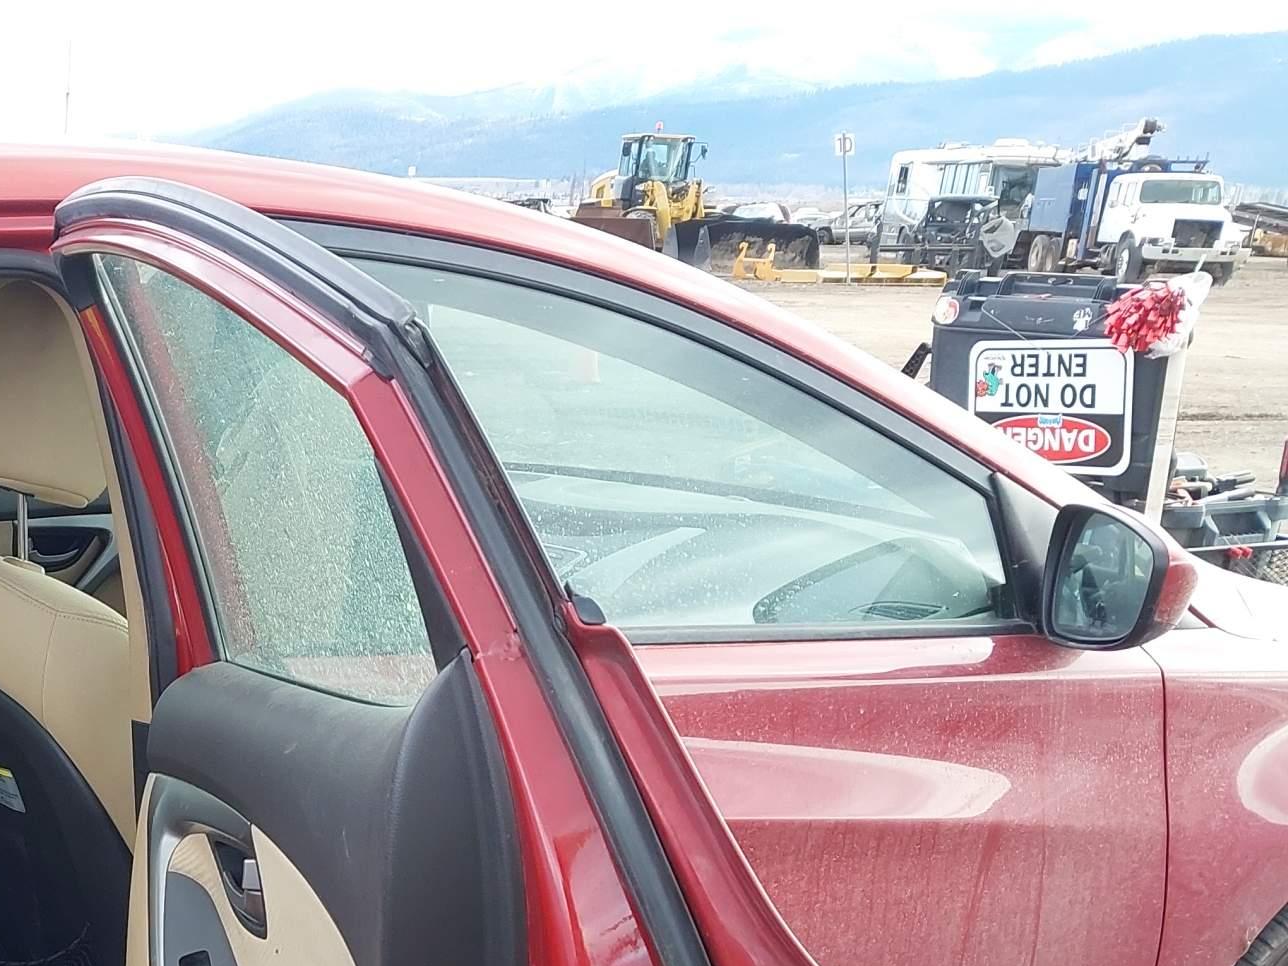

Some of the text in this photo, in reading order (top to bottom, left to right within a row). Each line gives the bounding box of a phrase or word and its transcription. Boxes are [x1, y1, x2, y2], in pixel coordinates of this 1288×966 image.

[1011, 353, 1087, 378] ENTER
[1000, 383, 1096, 409] DO NOT
[998, 426, 1096, 453] DANGE
